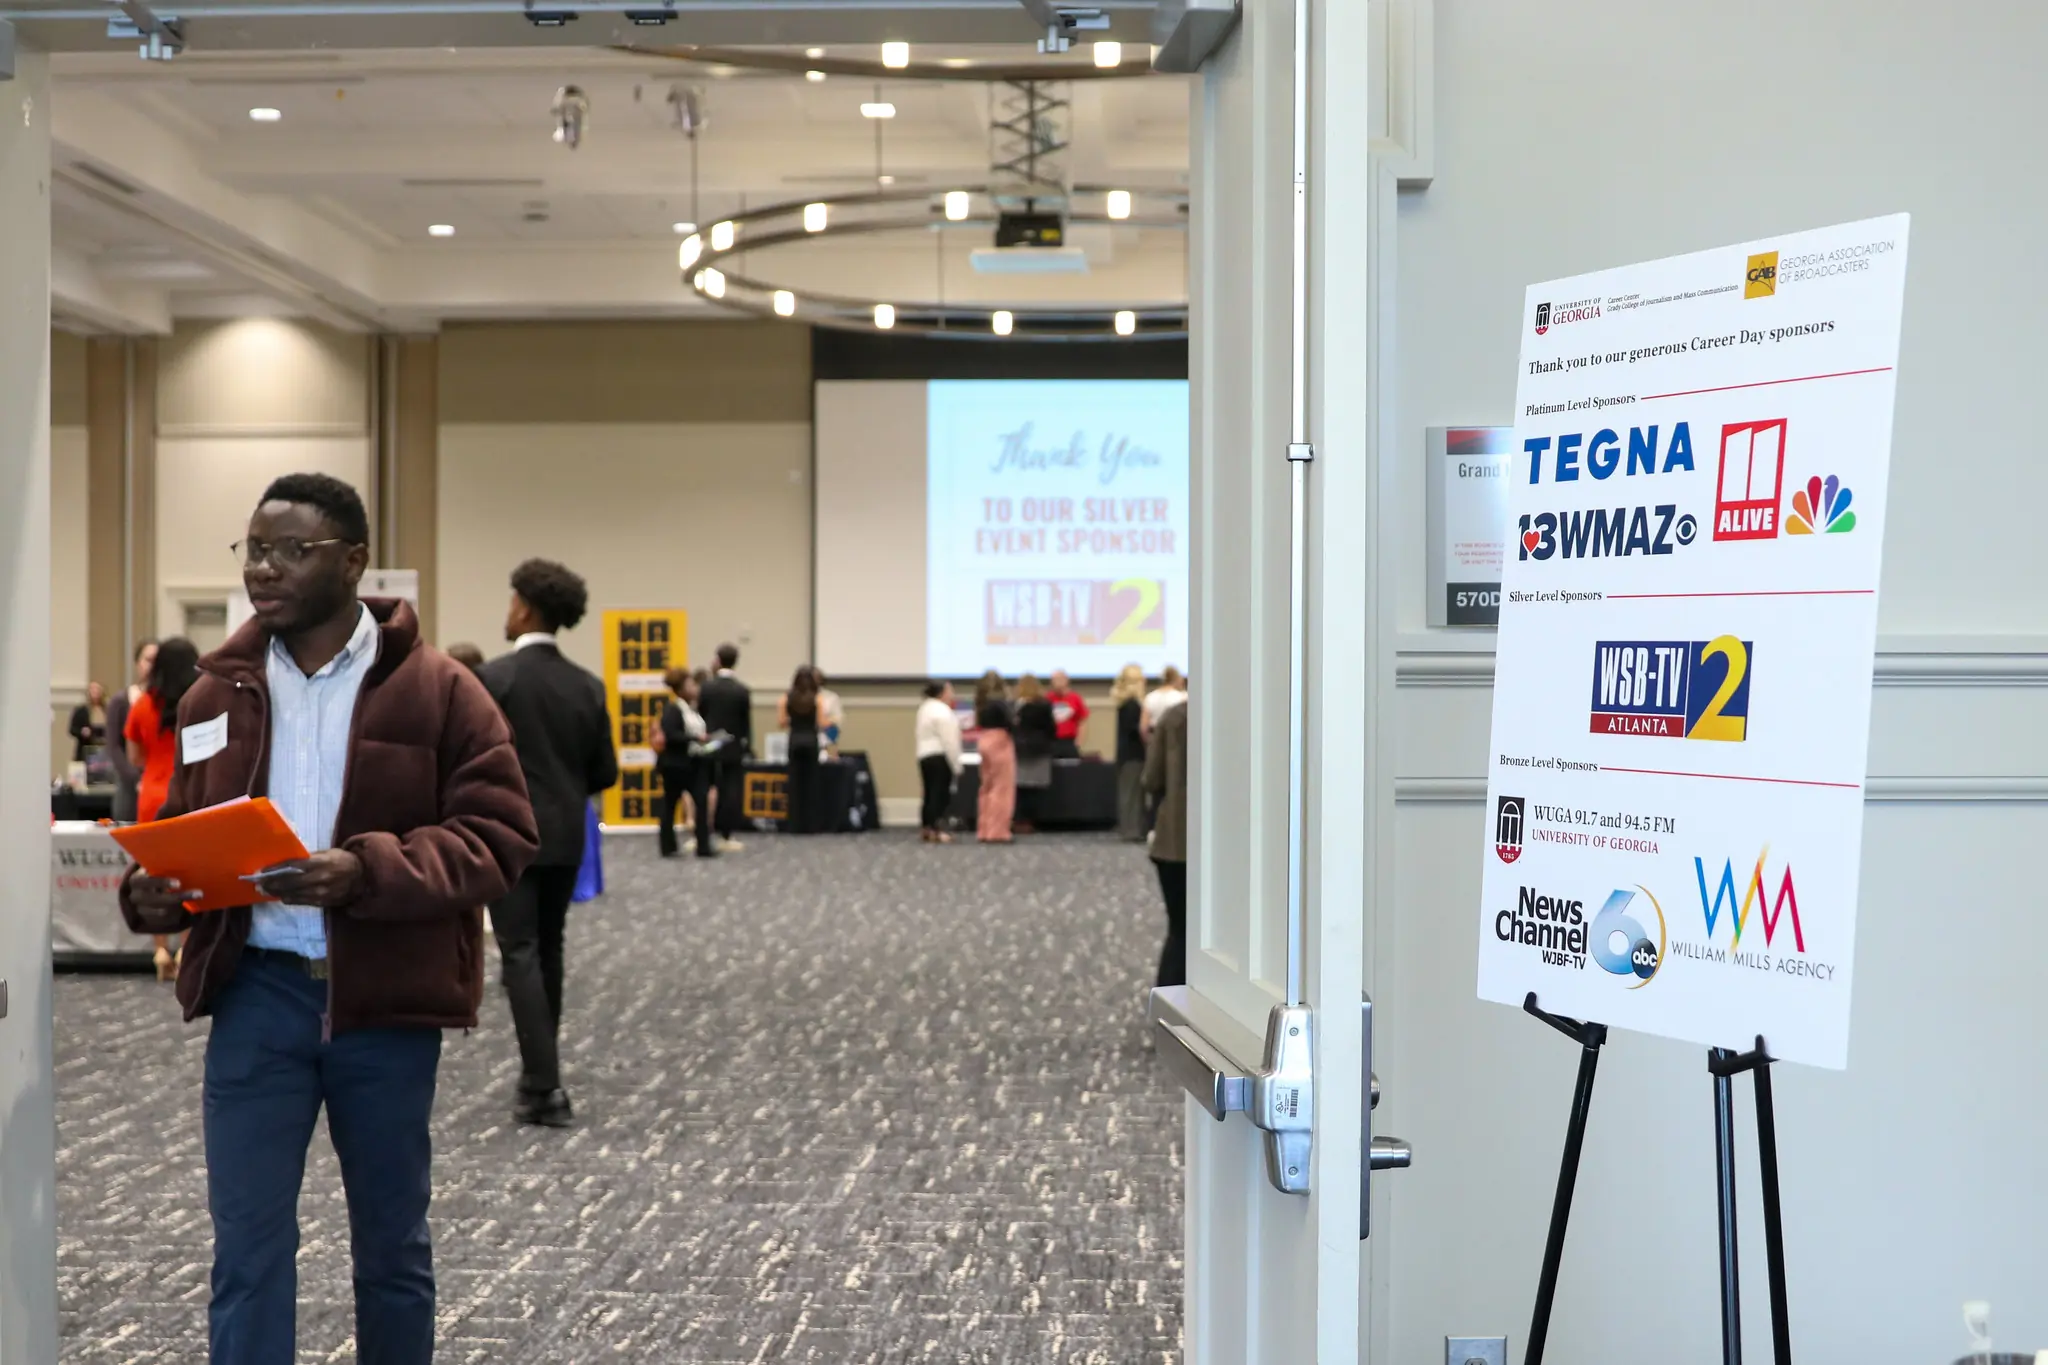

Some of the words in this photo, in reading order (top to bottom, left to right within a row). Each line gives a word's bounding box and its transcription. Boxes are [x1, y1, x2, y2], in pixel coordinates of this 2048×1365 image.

[1780, 253, 1825, 270] GEORGIA
[1828, 240, 1895, 261] ASSOCIATION
[1747, 266, 1776, 282] GAB
[1779, 271, 1791, 284] OF
[1794, 259, 1869, 282] BROADCASTERS
[1554, 299, 1592, 311] UNIVERSITY
[1621, 301, 1639, 310] College
[1683, 291, 1697, 299] Mass
[1697, 284, 1739, 296] Communication
[1553, 306, 1601, 325] GEORGIA
[1529, 358, 1564, 375] Thank
[1566, 357, 1587, 372] you
[1590, 353, 1601, 365] to
[1605, 350, 1627, 363] our
[1629, 341, 1687, 363] generous
[1691, 333, 1736, 350] Career
[1740, 329, 1766, 345] Day
[1769, 320, 1835, 342] sponsors
[1525, 402, 1565, 416] Platinum
[1567, 398, 1589, 411] Level
[1590, 393, 1636, 410] Sponsors
[990, 420, 1088, 474] Thank
[1099, 432, 1161, 486] You
[1524, 421, 1695, 484] TEGNA
[1459, 462, 1500, 478] Grand
[982, 497, 1012, 523] TO
[1021, 497, 1074, 523] OUR
[1083, 497, 1169, 523] SILVER
[1718, 508, 1774, 533] ALIVE
[975, 528, 1046, 554] EVENT
[1056, 528, 1176, 554] SPONSOR
[1508, 590, 1534, 603] Silver
[1535, 589, 1559, 602] Level
[1560, 588, 1602, 604] Sponsors
[1103, 577, 1163, 645] 2
[1600, 647, 1684, 708] WSB-TV
[1686, 634, 1748, 742] 2
[1608, 717, 1668, 734] ATLANTA
[1500, 754, 1530, 767] Bronze
[1532, 756, 1554, 769] Level
[1556, 758, 1598, 772] Sponsors
[1534, 805, 1573, 824] WUGA
[1575, 810, 1598, 826] 91.7
[1600, 812, 1621, 828] and
[1624, 815, 1650, 831] 94.5
[1653, 817, 1676, 834] FM
[1532, 828, 1590, 846] UNIVERSITY
[1593, 835, 1607, 848] OF
[1610, 838, 1659, 854] GEORGIA
[1519, 886, 1583, 925] News
[1495, 910, 1587, 955] Channel
[1541, 949, 1586, 970] WJBF-TV
[1632, 947, 1658, 967] abc
[1671, 940, 1726, 964] WILLIAM
[1733, 952, 1771, 971] MILLS
[1776, 958, 1835, 981] AGENCY
